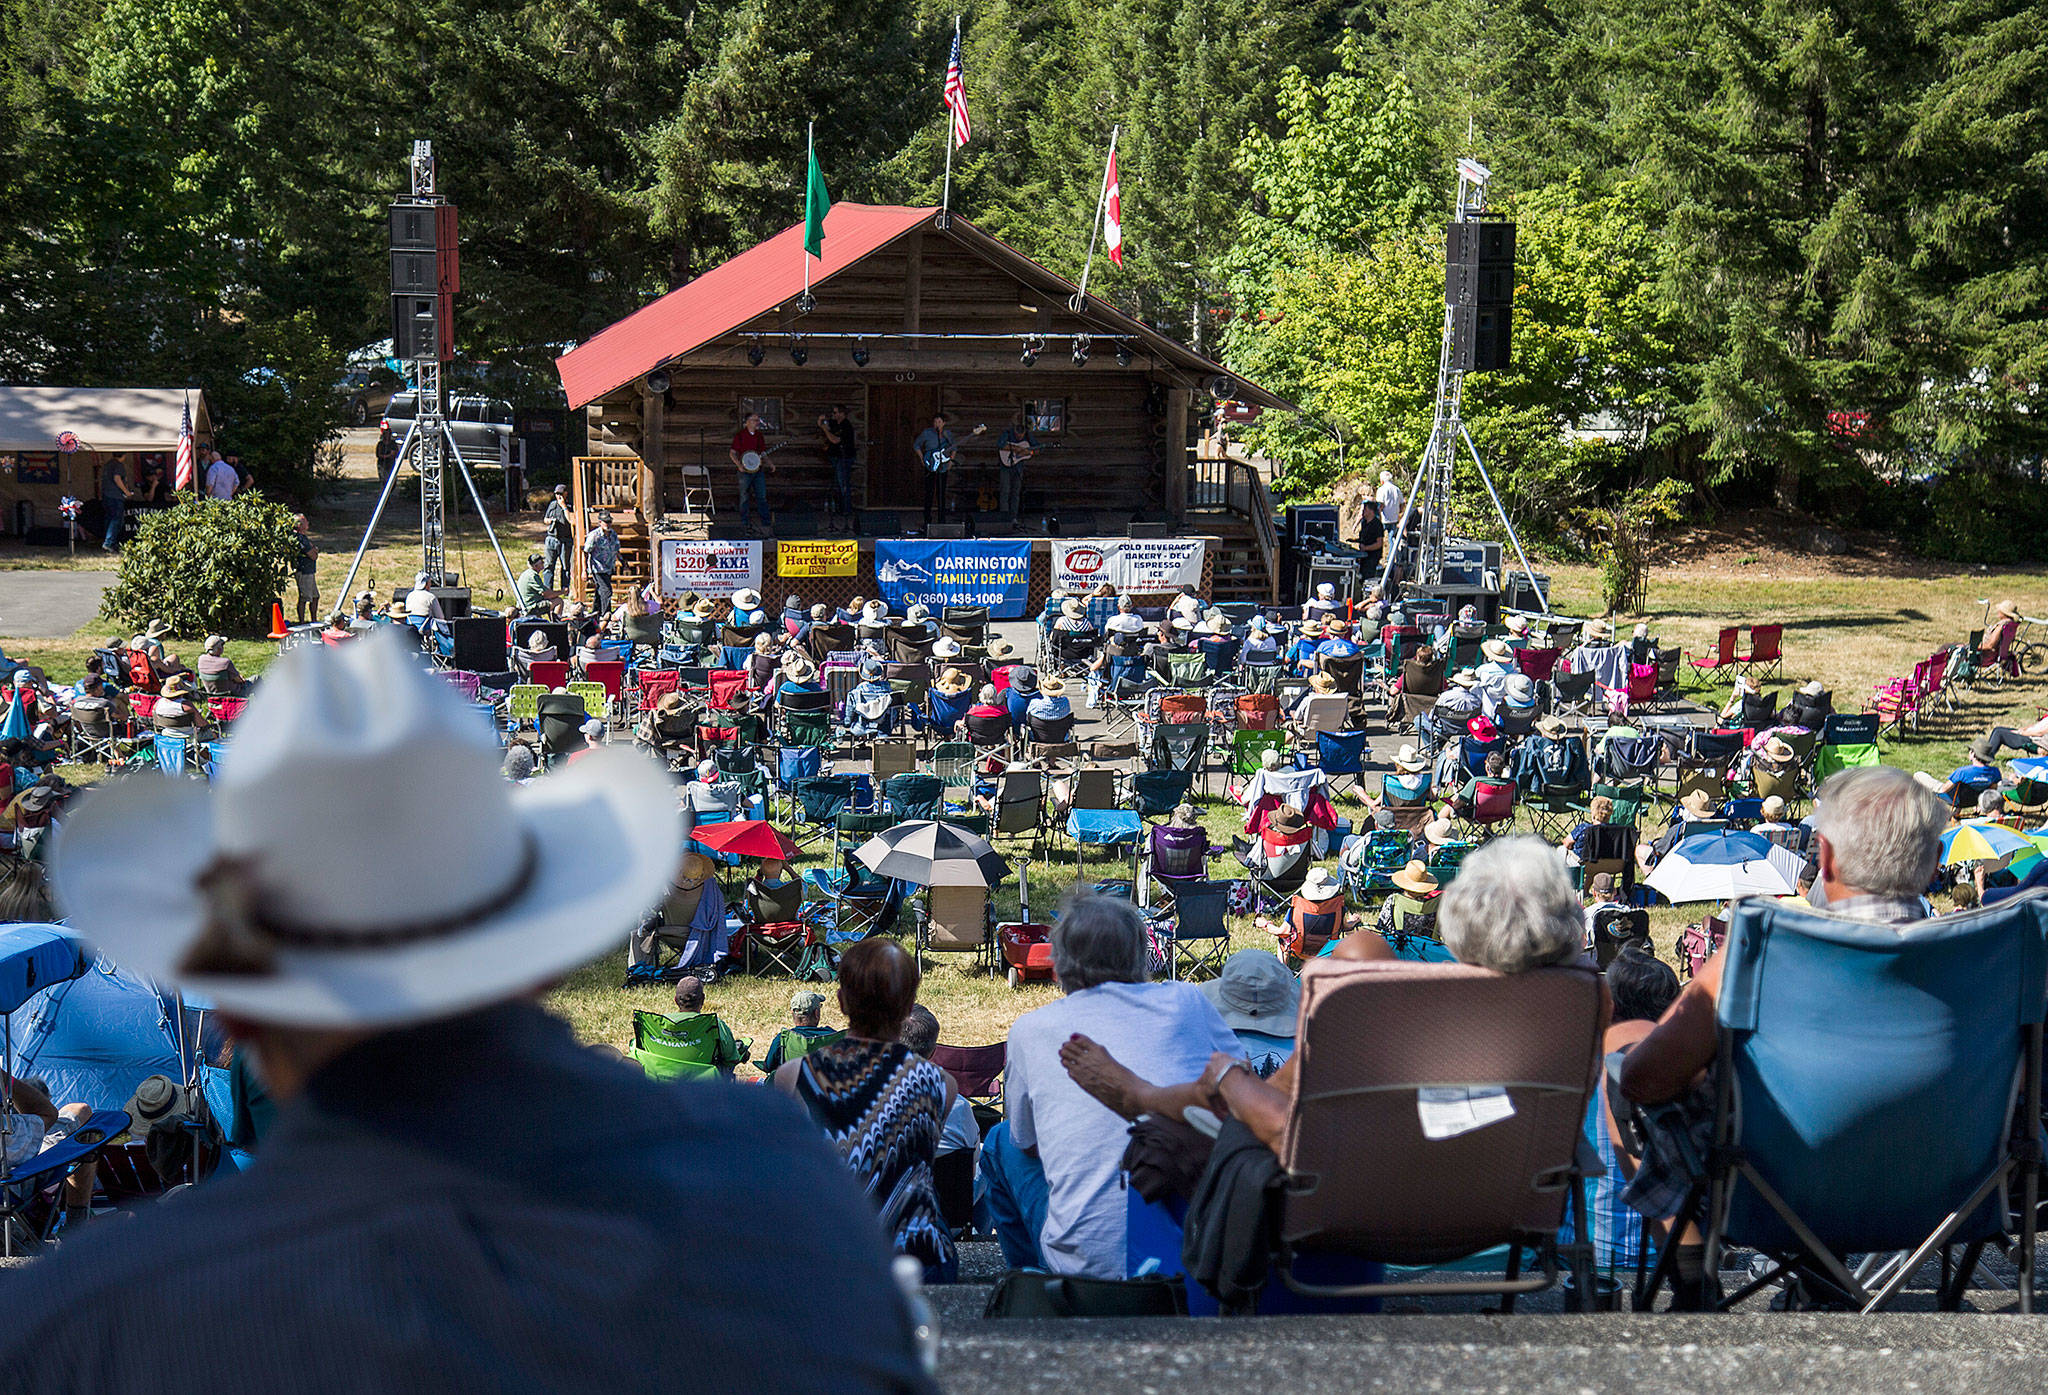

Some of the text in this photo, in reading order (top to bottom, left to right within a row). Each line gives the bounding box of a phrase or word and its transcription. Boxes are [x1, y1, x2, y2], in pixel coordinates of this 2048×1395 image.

[675, 547, 749, 556] CLASSIC COUNTRY
[781, 543, 854, 555] Darrington
[1064, 544, 1105, 555] DARRINGTON
[1118, 543, 1198, 551] COLD BEVERAGES
[785, 555, 849, 566] Hardware
[1125, 552, 1162, 560] BAKERY
[1169, 552, 1191, 560] DELI
[675, 556, 749, 569] 1520 KXA
[935, 556, 1028, 570] DARRINGTON
[1134, 561, 1181, 569] ESPRESSO
[935, 573, 1027, 585] FAMILY DENTAL
[1058, 573, 1110, 581] HOMETOWN
[1149, 570, 1165, 578] ICE
[918, 592, 1004, 605] (360) 436-1008
